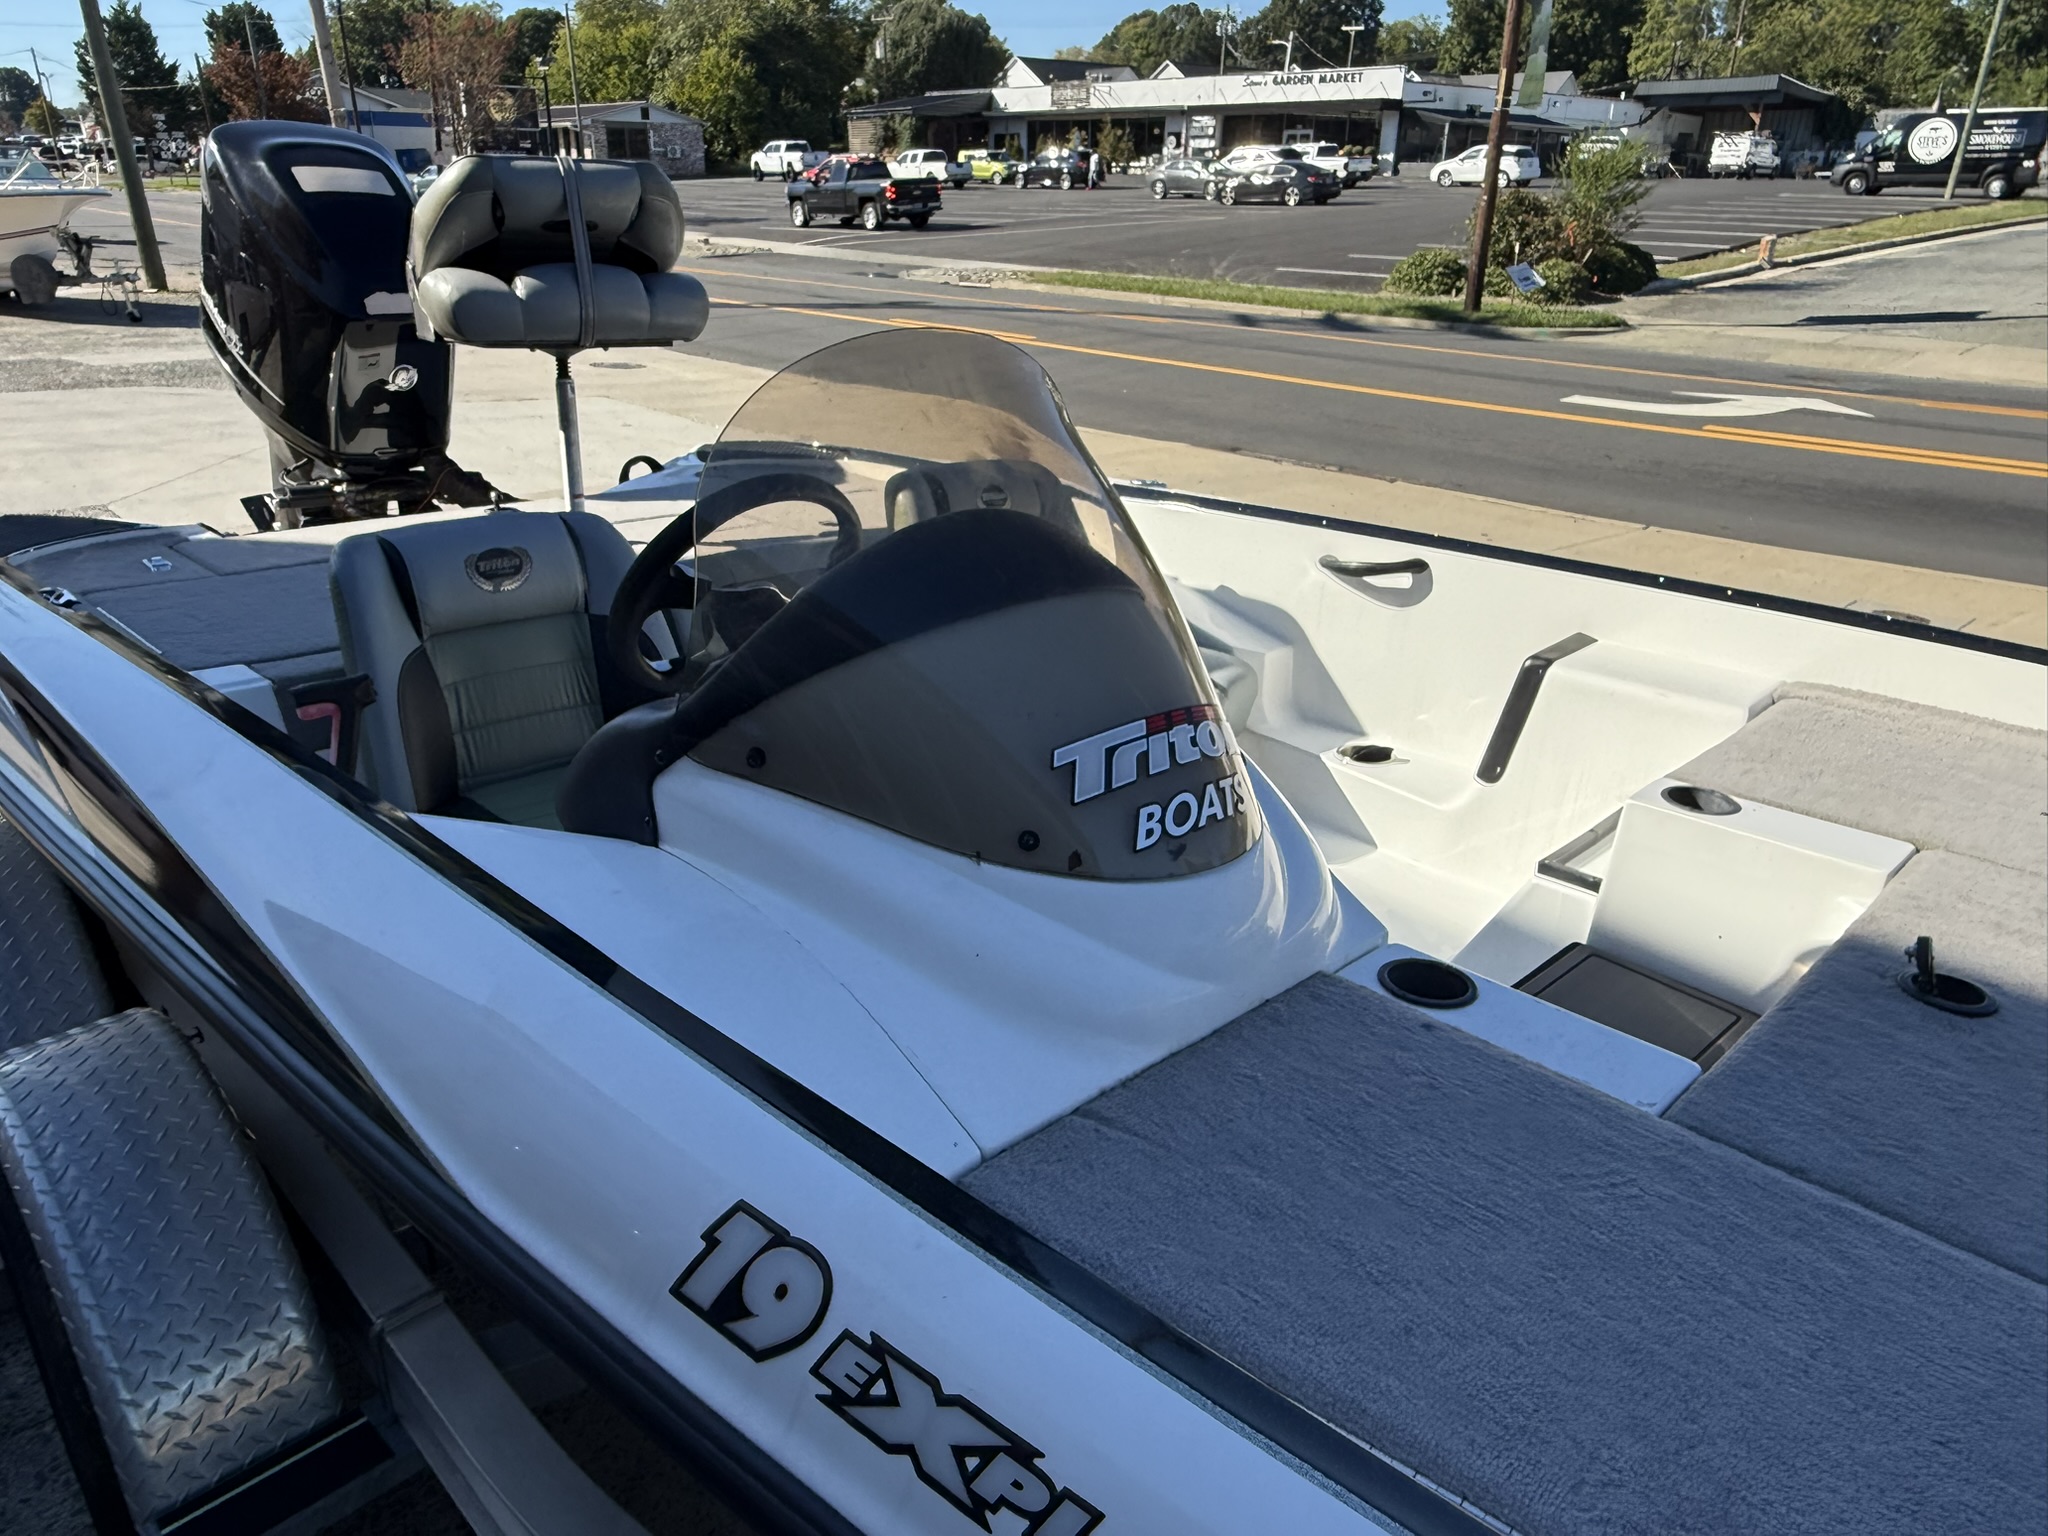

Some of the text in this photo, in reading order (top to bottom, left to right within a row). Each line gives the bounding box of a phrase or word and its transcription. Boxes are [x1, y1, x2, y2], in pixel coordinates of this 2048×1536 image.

[1272, 75, 1314, 86] GARDEN
[1318, 72, 1364, 84] MARKET
[1051, 718, 1228, 804] Trito
[1134, 771, 1248, 852] BOATS
[670, 1199, 833, 1363] 19
